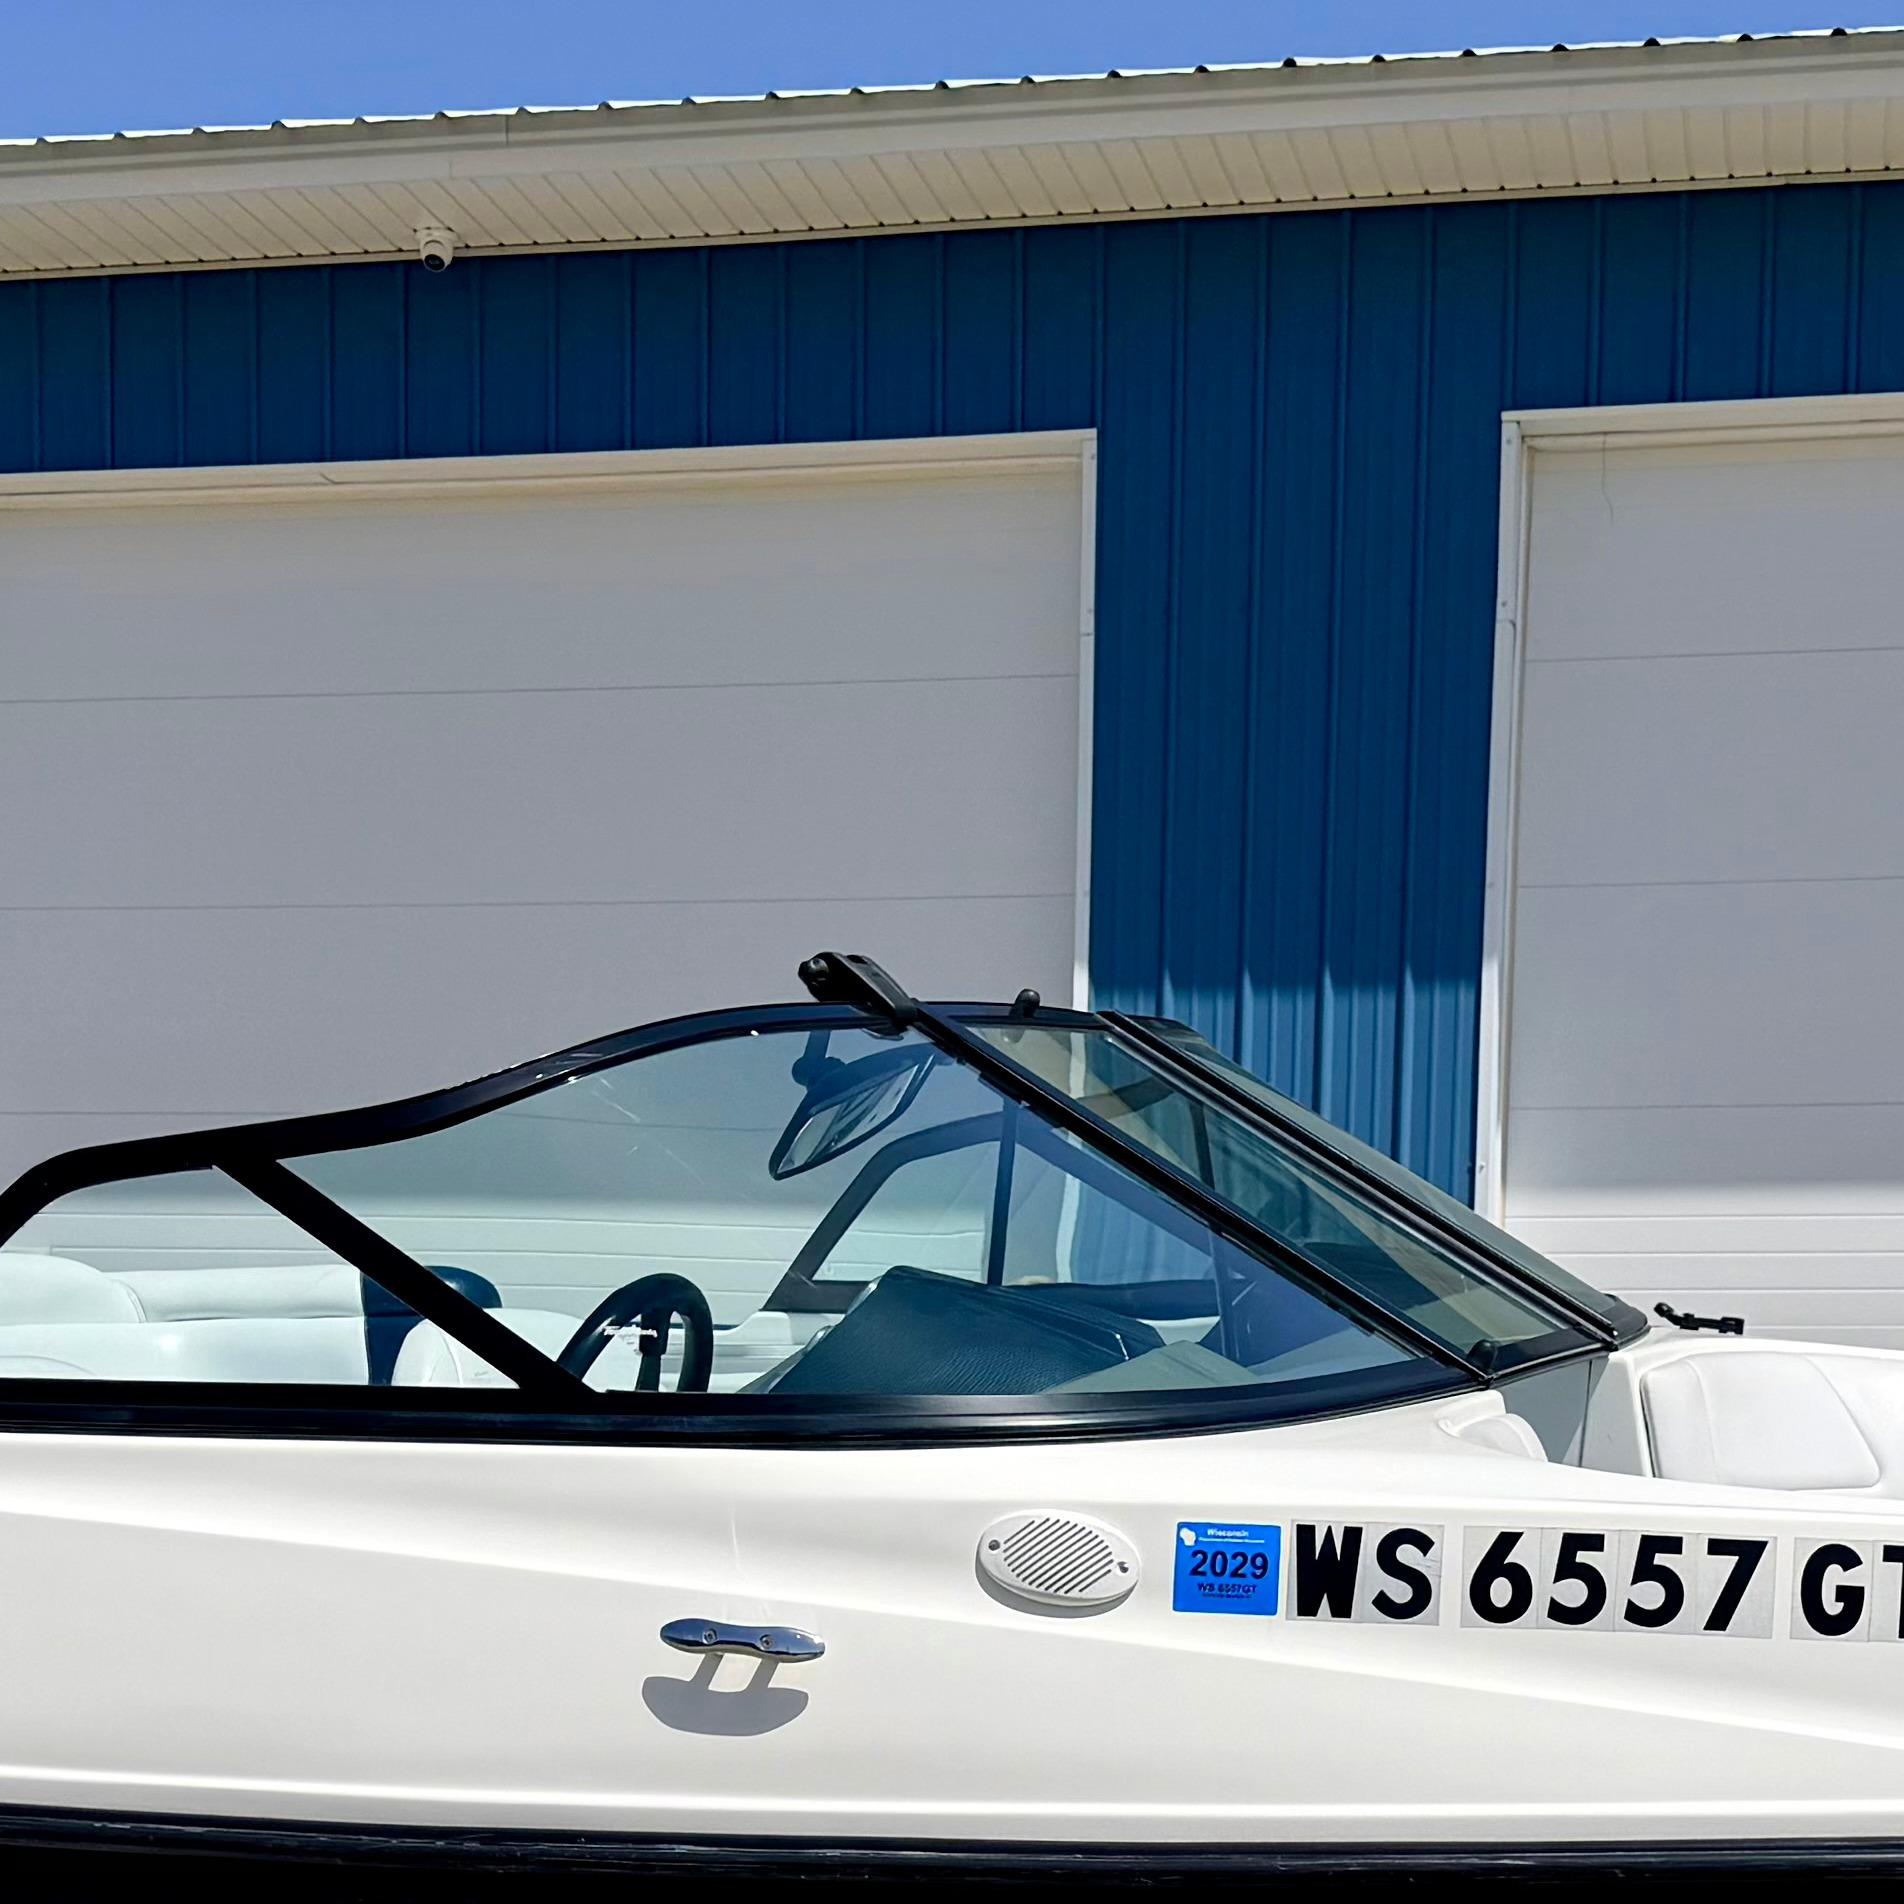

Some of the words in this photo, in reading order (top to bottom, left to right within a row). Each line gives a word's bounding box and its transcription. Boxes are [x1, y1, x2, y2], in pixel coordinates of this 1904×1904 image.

[1189, 1549, 1269, 1580] 2029
[1296, 1524, 1436, 1620] WS
[1468, 1530, 1772, 1632] 6557
